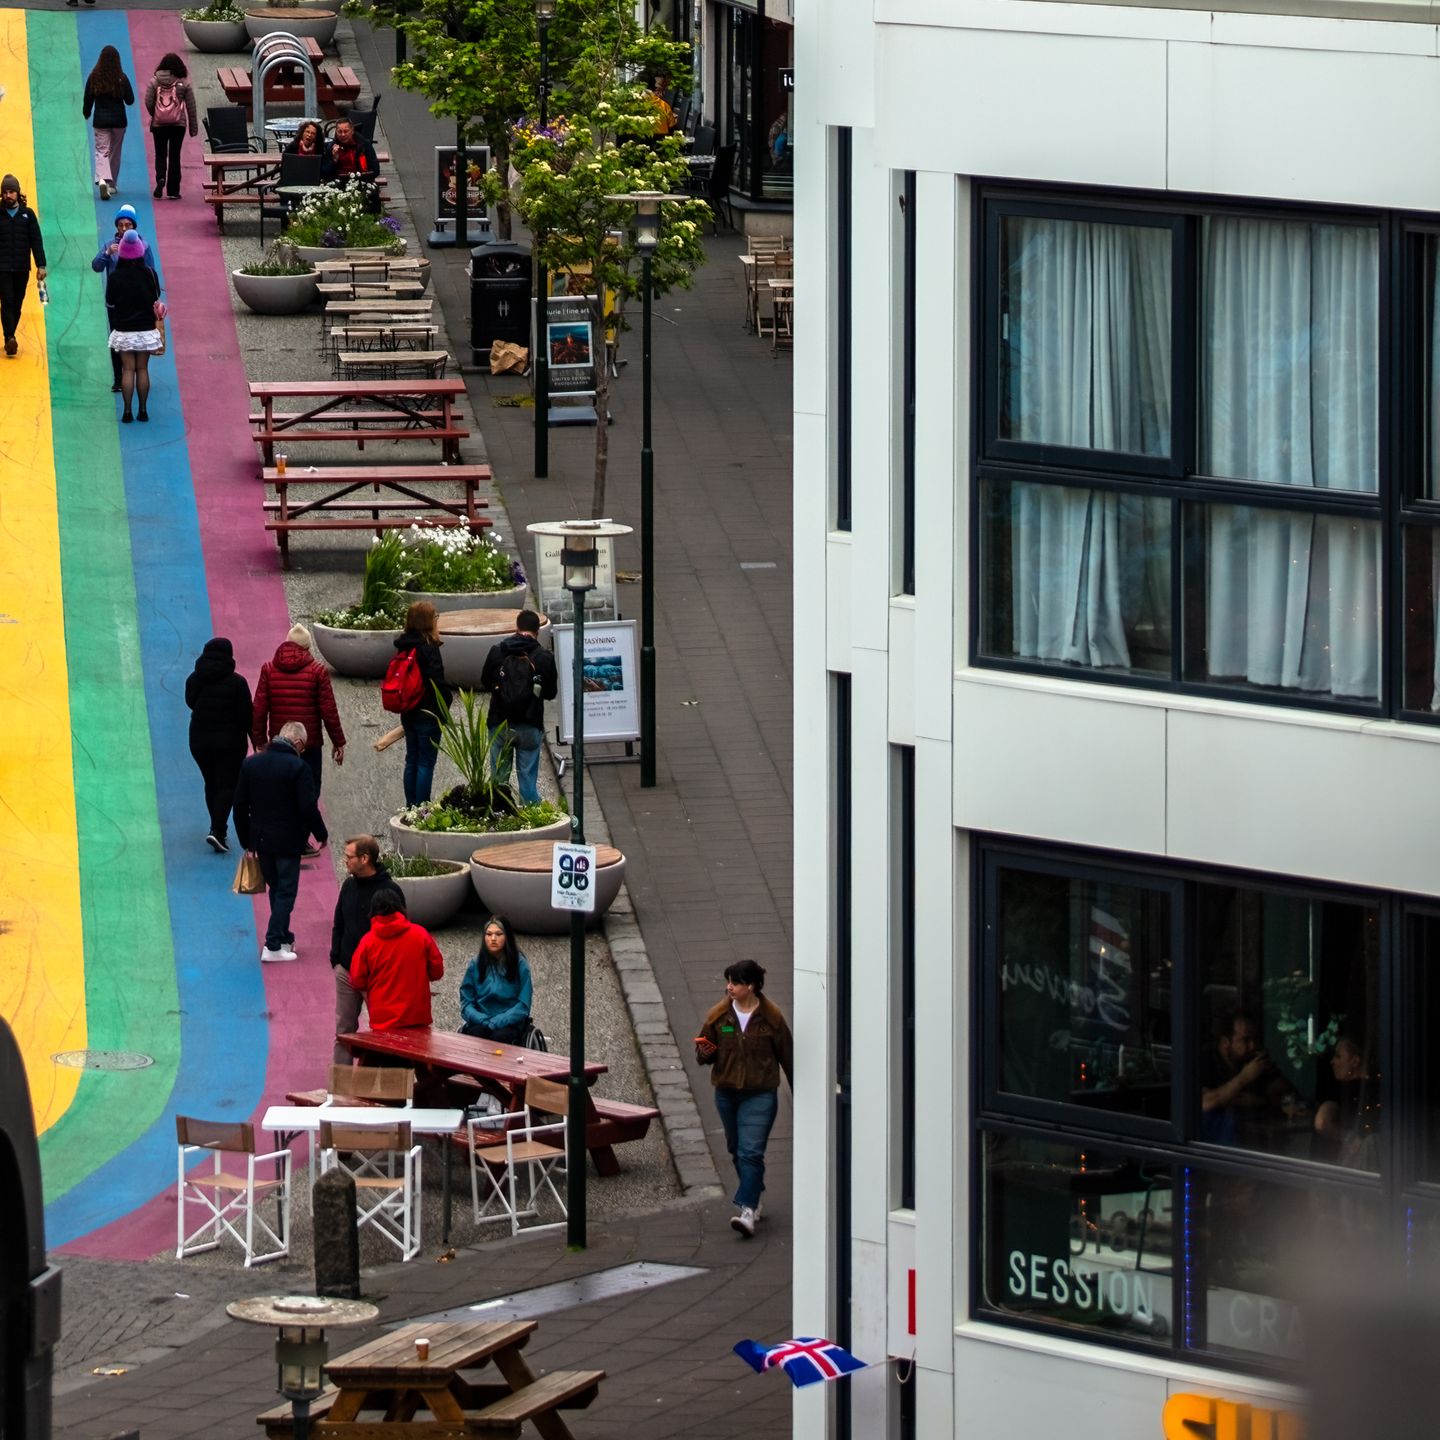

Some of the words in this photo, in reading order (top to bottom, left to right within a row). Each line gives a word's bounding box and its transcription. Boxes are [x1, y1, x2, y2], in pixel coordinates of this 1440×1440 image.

[467, 191, 485, 199] HIPS
[567, 307, 578, 315] fine
[1009, 1250, 1153, 1325] SESSION
